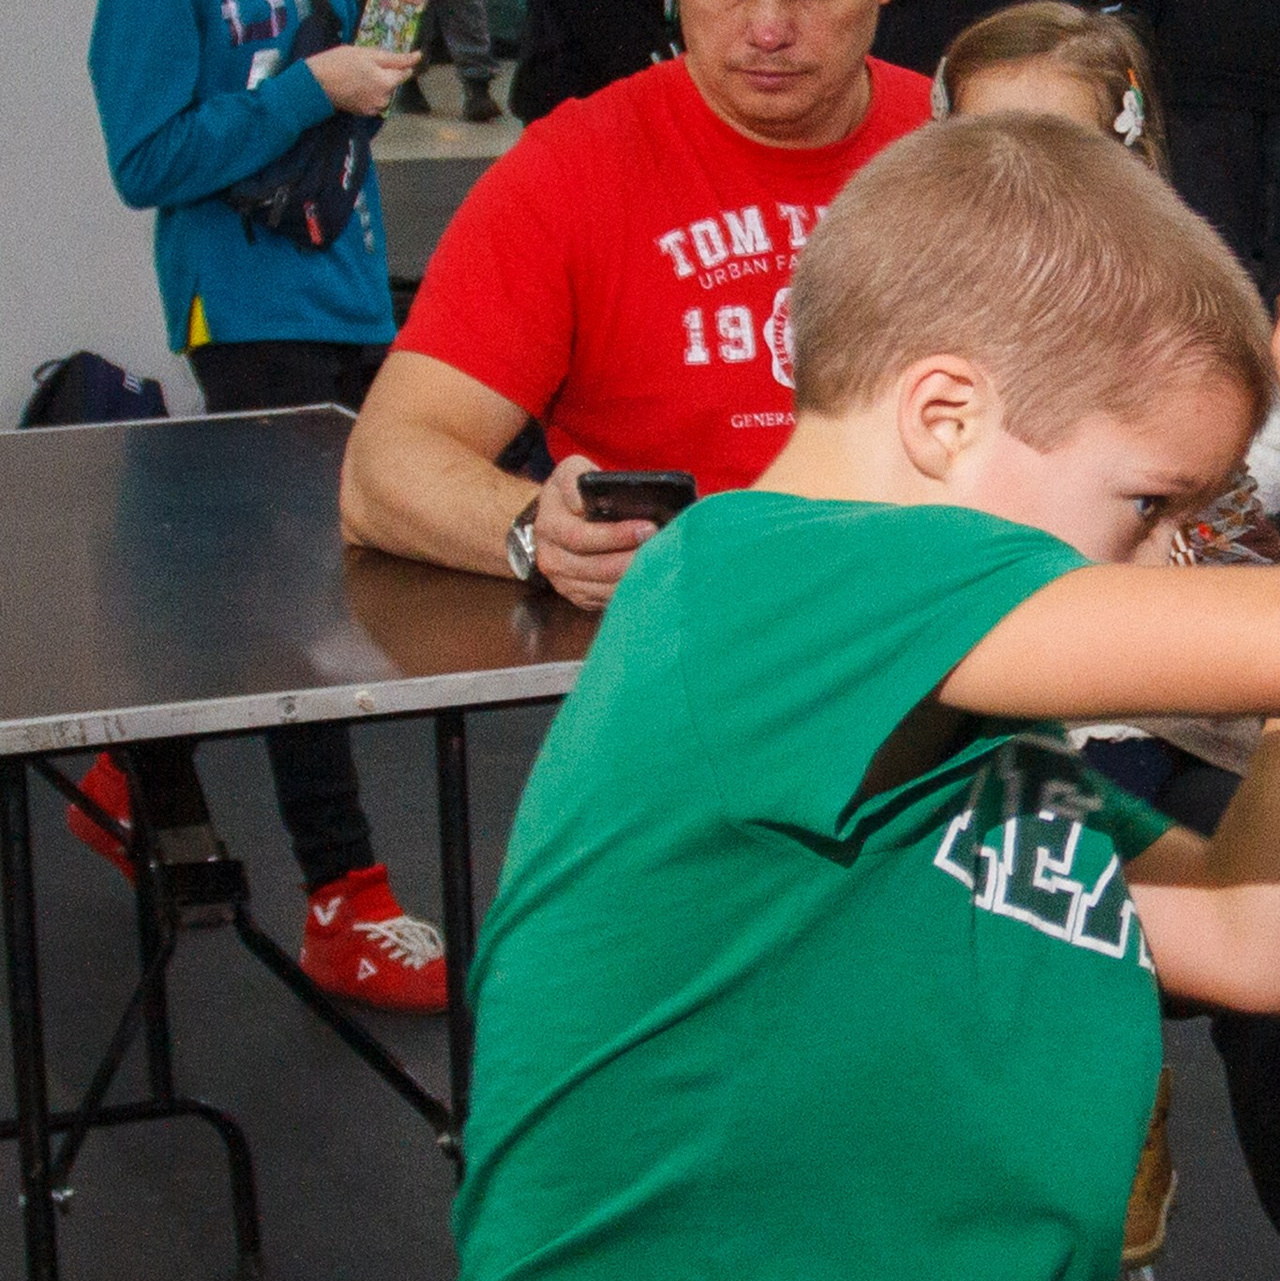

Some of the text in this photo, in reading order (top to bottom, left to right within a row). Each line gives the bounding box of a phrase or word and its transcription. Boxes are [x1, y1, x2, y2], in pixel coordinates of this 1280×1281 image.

[655, 201, 830, 279] TOM T
[699, 254, 800, 289] URBAN FA
[683, 305, 756, 365] 19
[731, 411, 796, 429] GENERA
